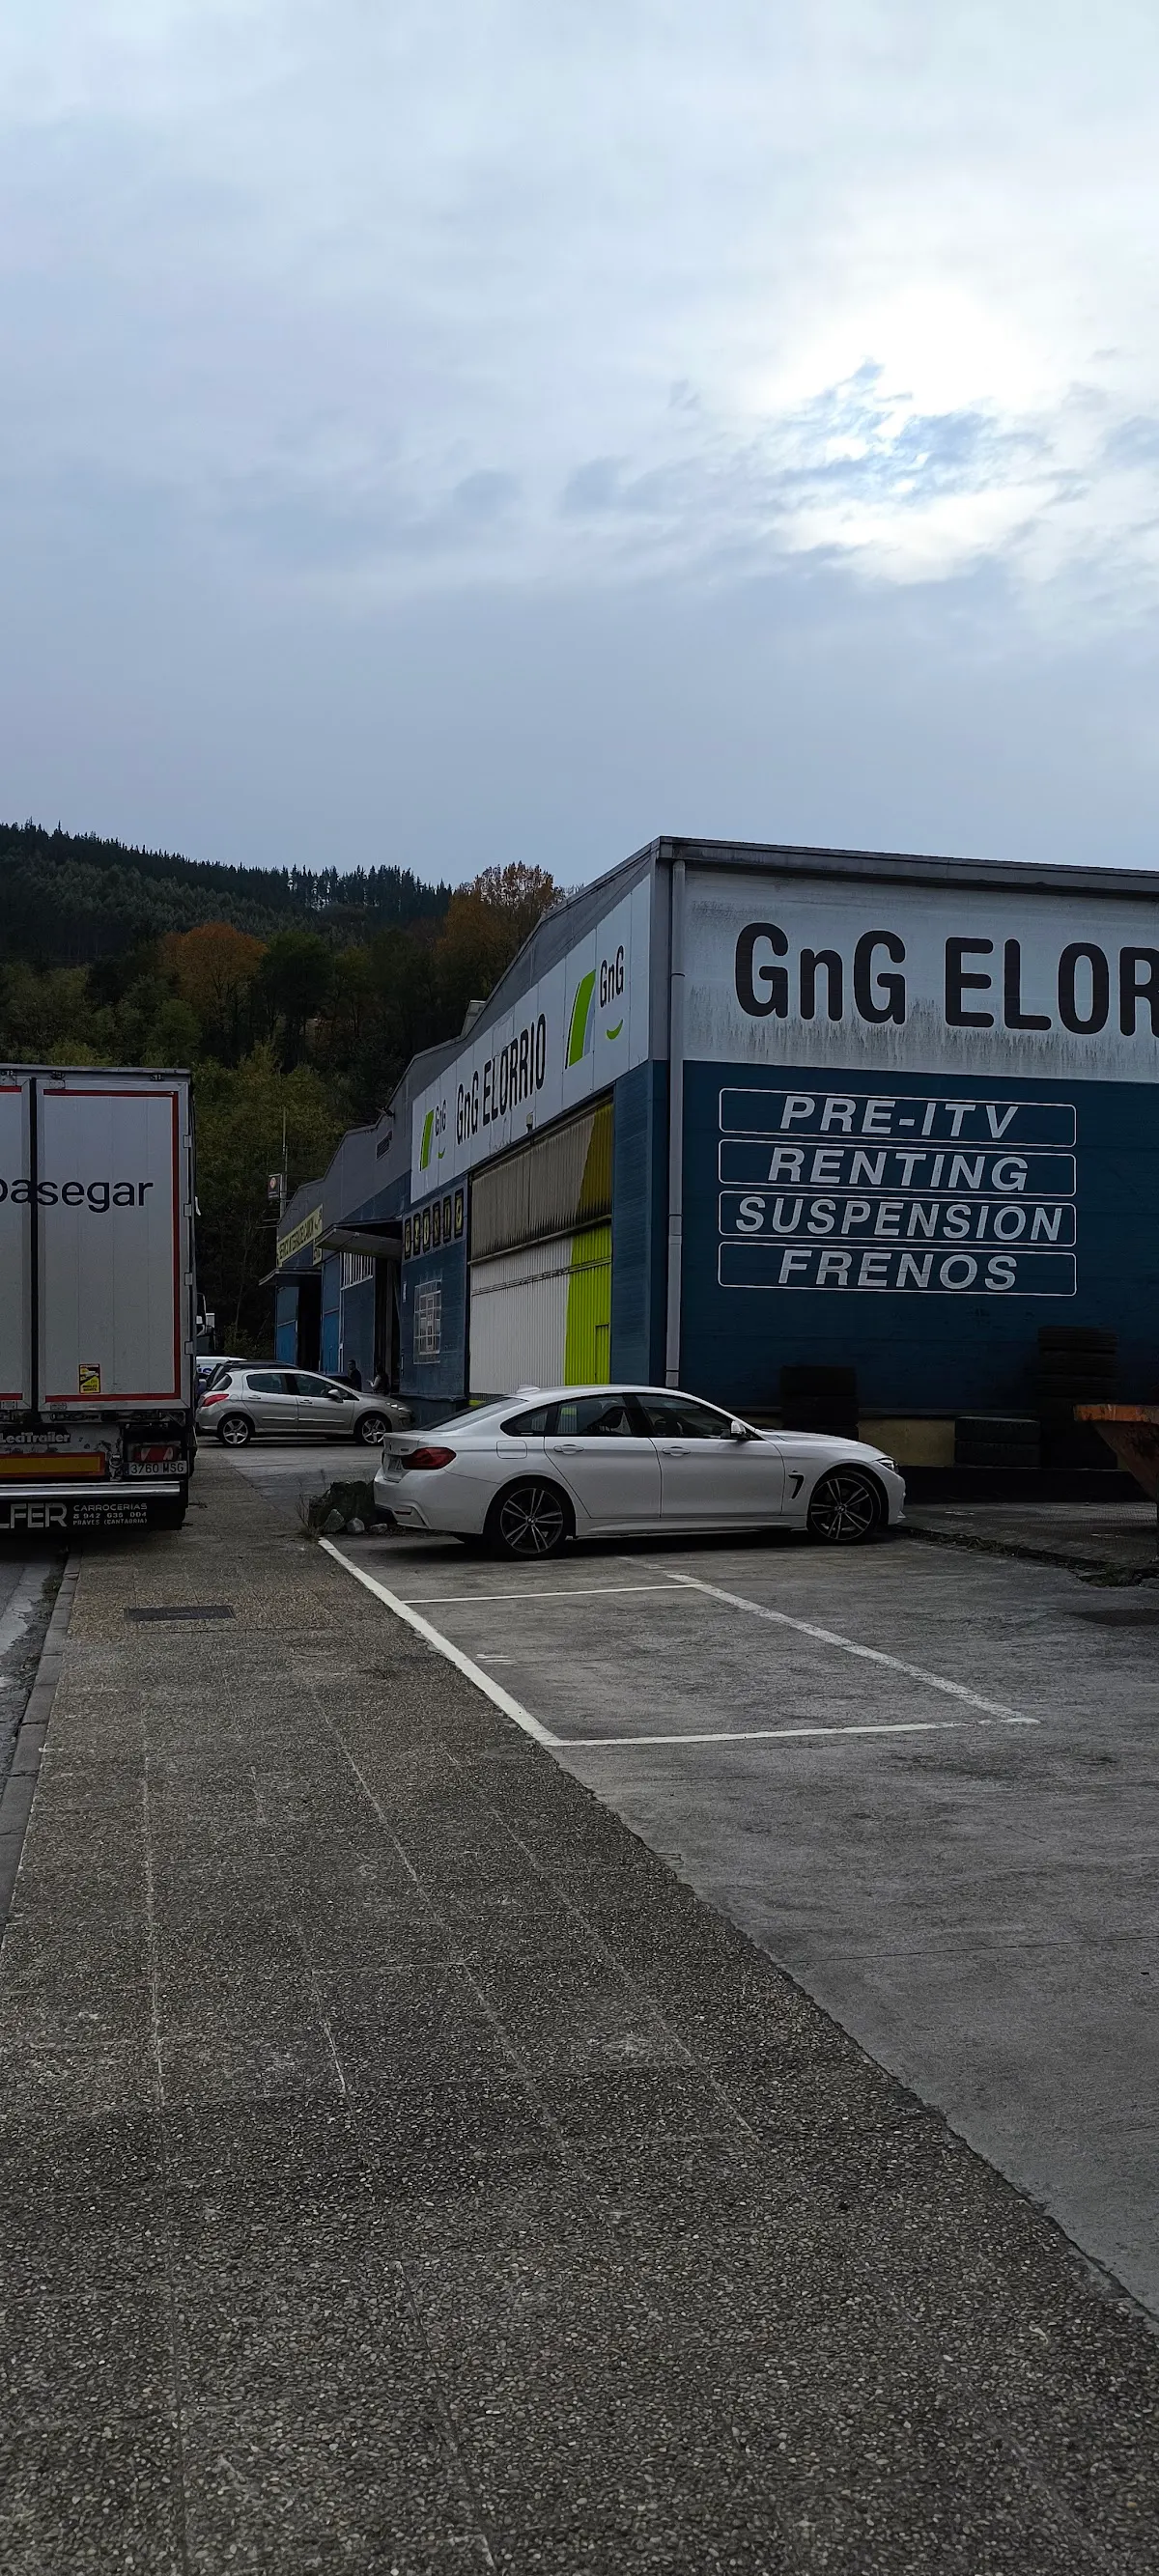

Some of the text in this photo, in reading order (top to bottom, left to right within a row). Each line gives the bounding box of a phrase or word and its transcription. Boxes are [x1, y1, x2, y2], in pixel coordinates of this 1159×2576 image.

[600, 944, 624, 1008] GnG
[734, 921, 906, 1025] GnG
[456, 1013, 546, 1145] GnG ELORRIO
[779, 1095, 1019, 1138] PRE-ITV
[768, 1147, 1029, 1191] RENTING
[736, 1195, 1063, 1242] SUSPENSION
[778, 1249, 1018, 1291] FRENOS
[131, 1463, 159, 1473] 3760
[73, 1502, 148, 1512] CARROCERIAS
